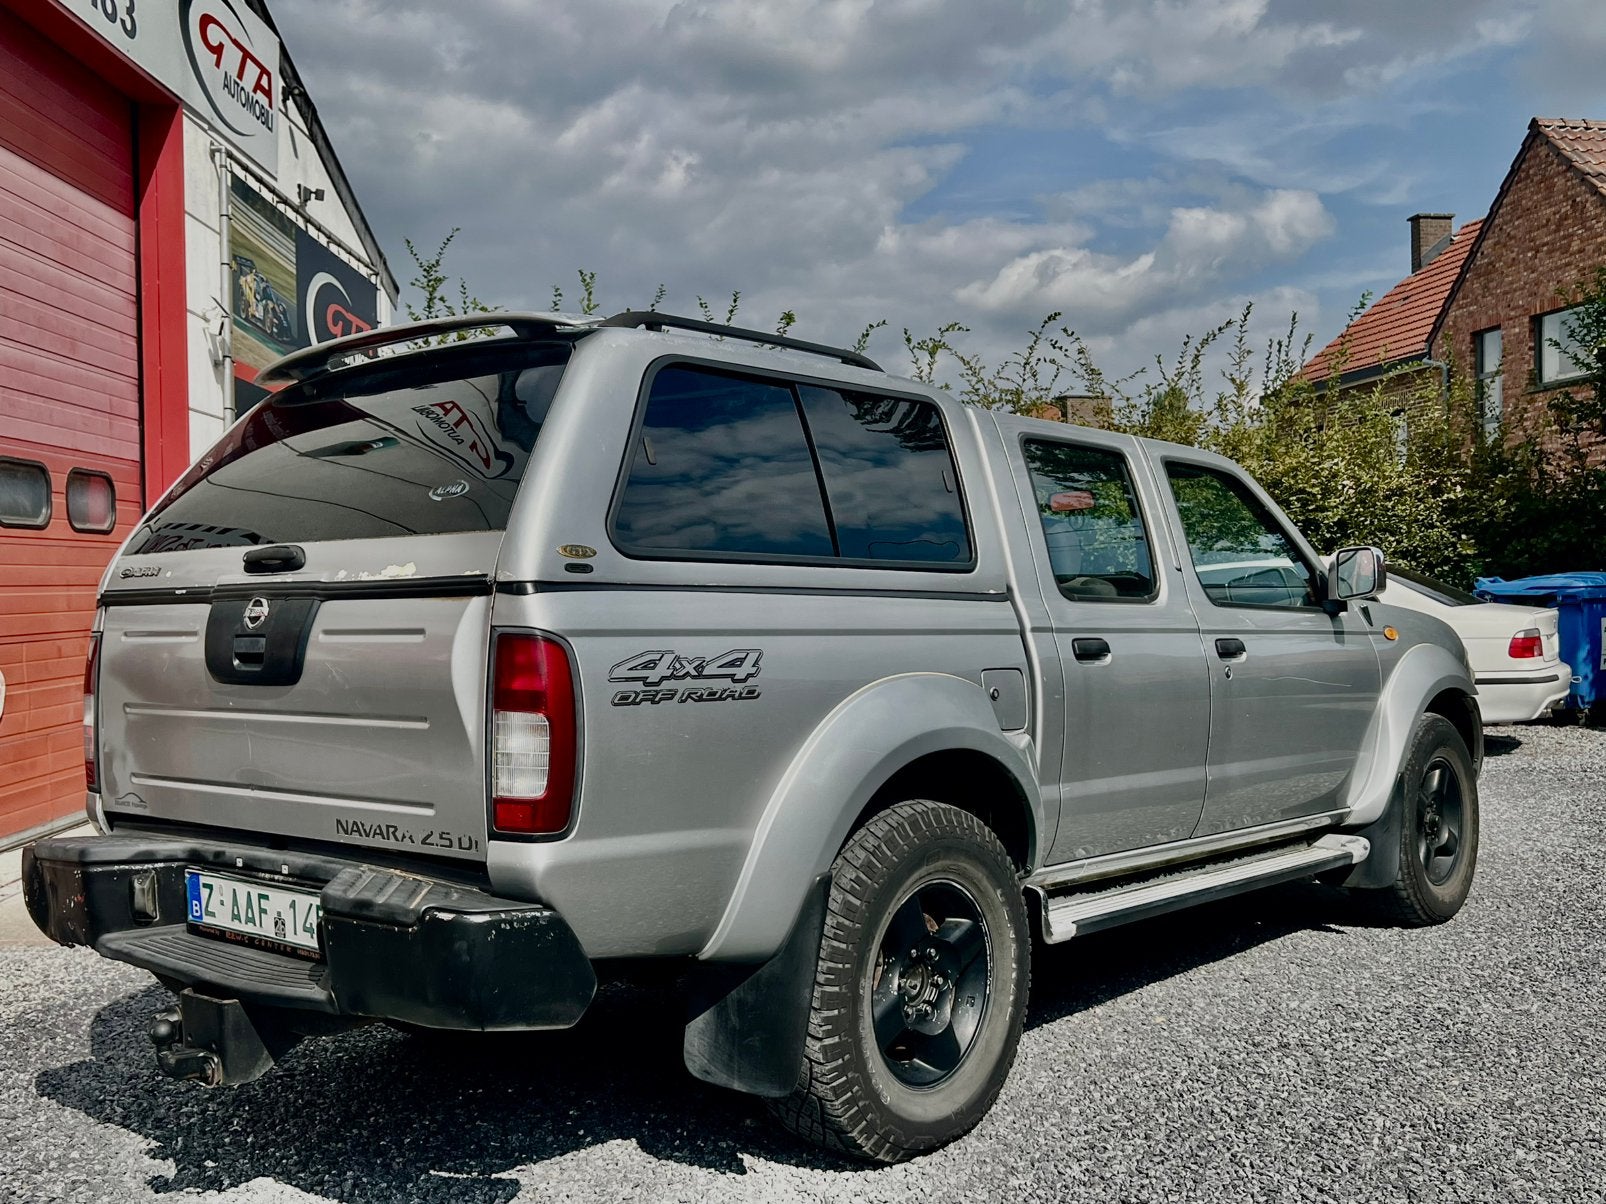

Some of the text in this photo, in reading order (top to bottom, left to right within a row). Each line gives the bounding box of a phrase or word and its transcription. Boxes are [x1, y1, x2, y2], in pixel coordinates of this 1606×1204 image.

[199, 13, 273, 110] GTA
[222, 70, 274, 133] AUTOMOBILI
[434, 483, 464, 495] ALPHA
[608, 648, 764, 687] 4x4
[610, 685, 762, 707] OFF ROAD
[335, 817, 416, 844] NAVARA
[420, 830, 454, 849] 2.5
[192, 900, 201, 917] B
